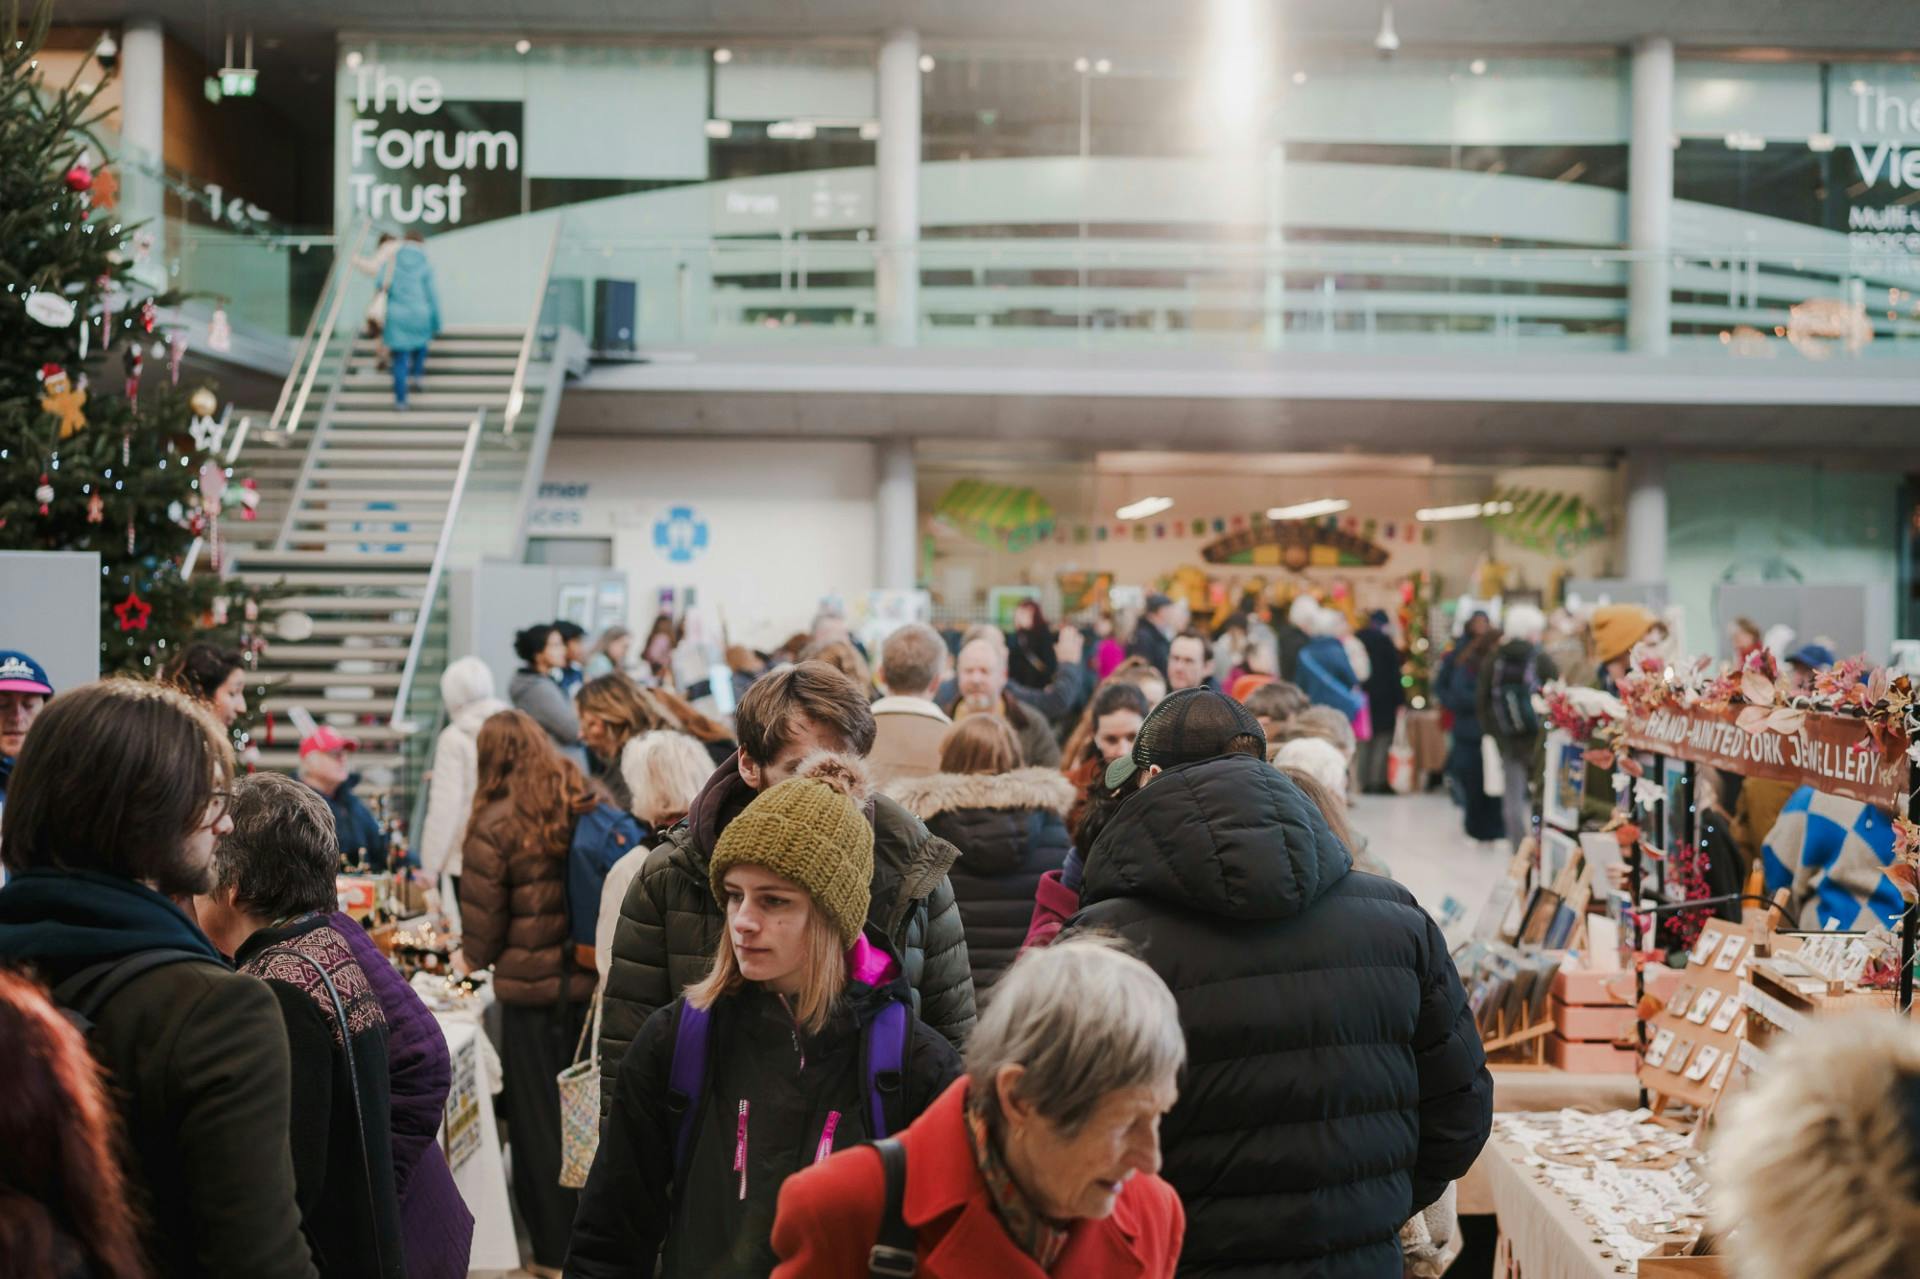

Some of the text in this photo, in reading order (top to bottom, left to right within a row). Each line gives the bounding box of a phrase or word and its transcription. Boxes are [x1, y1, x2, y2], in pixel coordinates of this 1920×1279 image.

[353, 64, 442, 115] The
[352, 119, 518, 170] Forum
[349, 173, 466, 224] Trust
